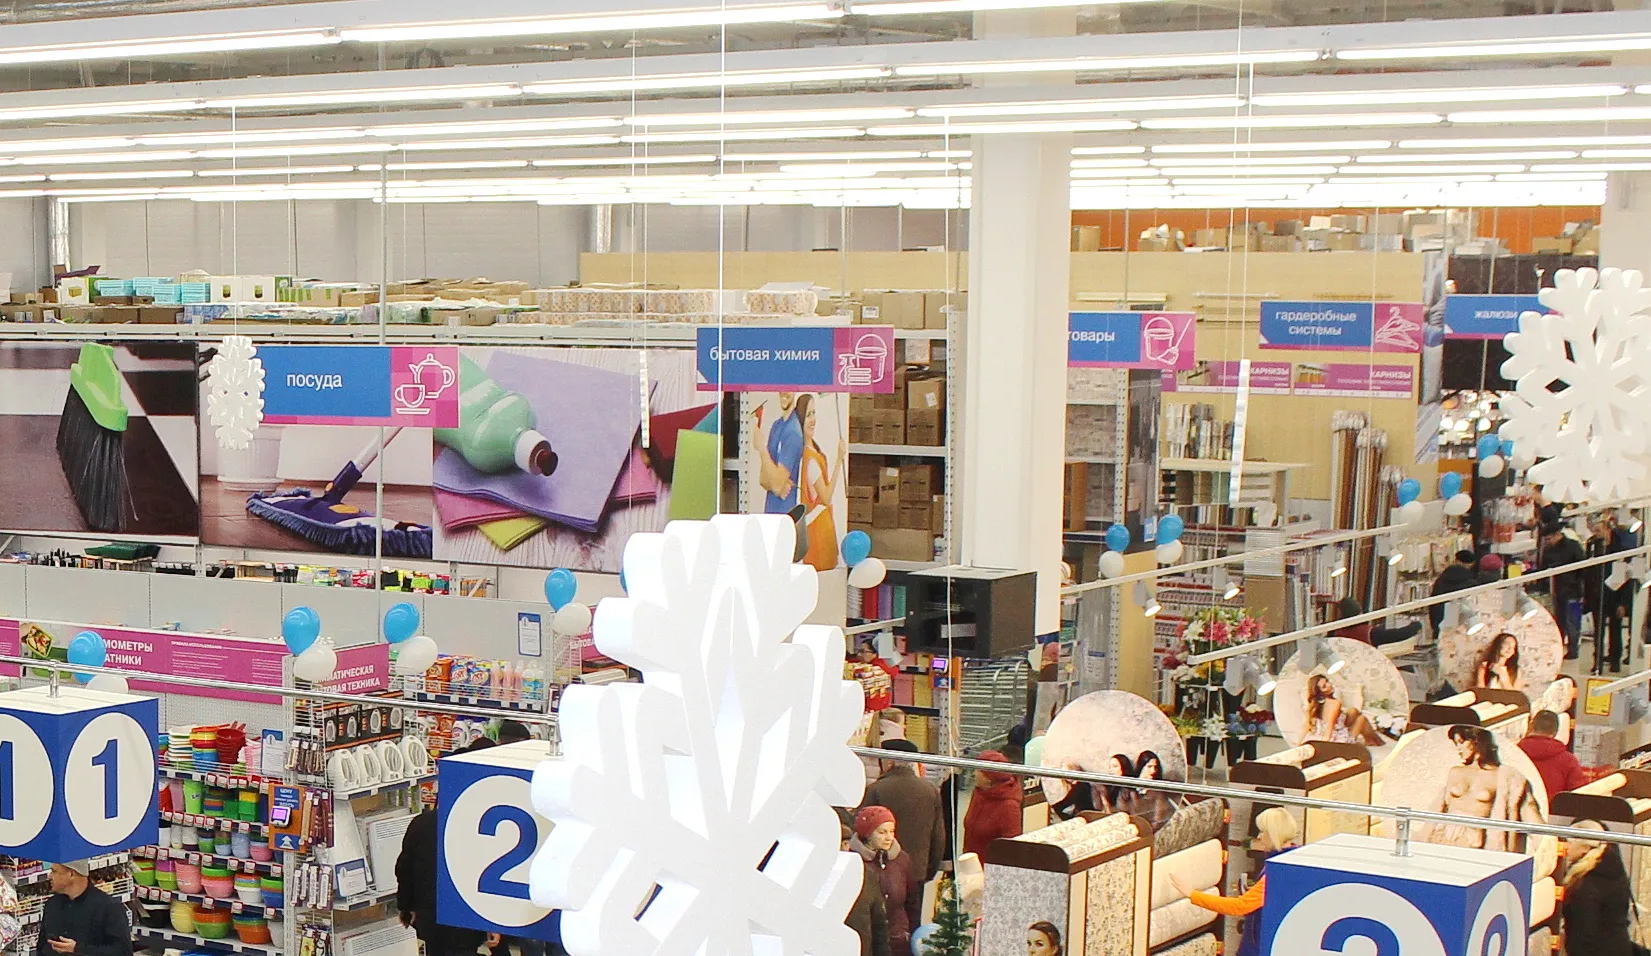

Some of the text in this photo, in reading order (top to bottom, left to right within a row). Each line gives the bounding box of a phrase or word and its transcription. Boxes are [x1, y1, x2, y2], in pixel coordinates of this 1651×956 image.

[1275, 308, 1358, 324] гардеробные
[1474, 310, 1518, 320] жалюзи
[1068, 331, 1115, 343] овары
[1288, 324, 1342, 336] системы
[709, 345, 820, 362] бытовая химия
[286, 373, 343, 390] посуда
[103, 639, 153, 652] МОМЕТРЫ
[105, 653, 142, 666] АТНИКИ
[347, 677, 381, 691] ТЕХНИКА
[92, 738, 119, 820] 1
[477, 804, 538, 899] 2
